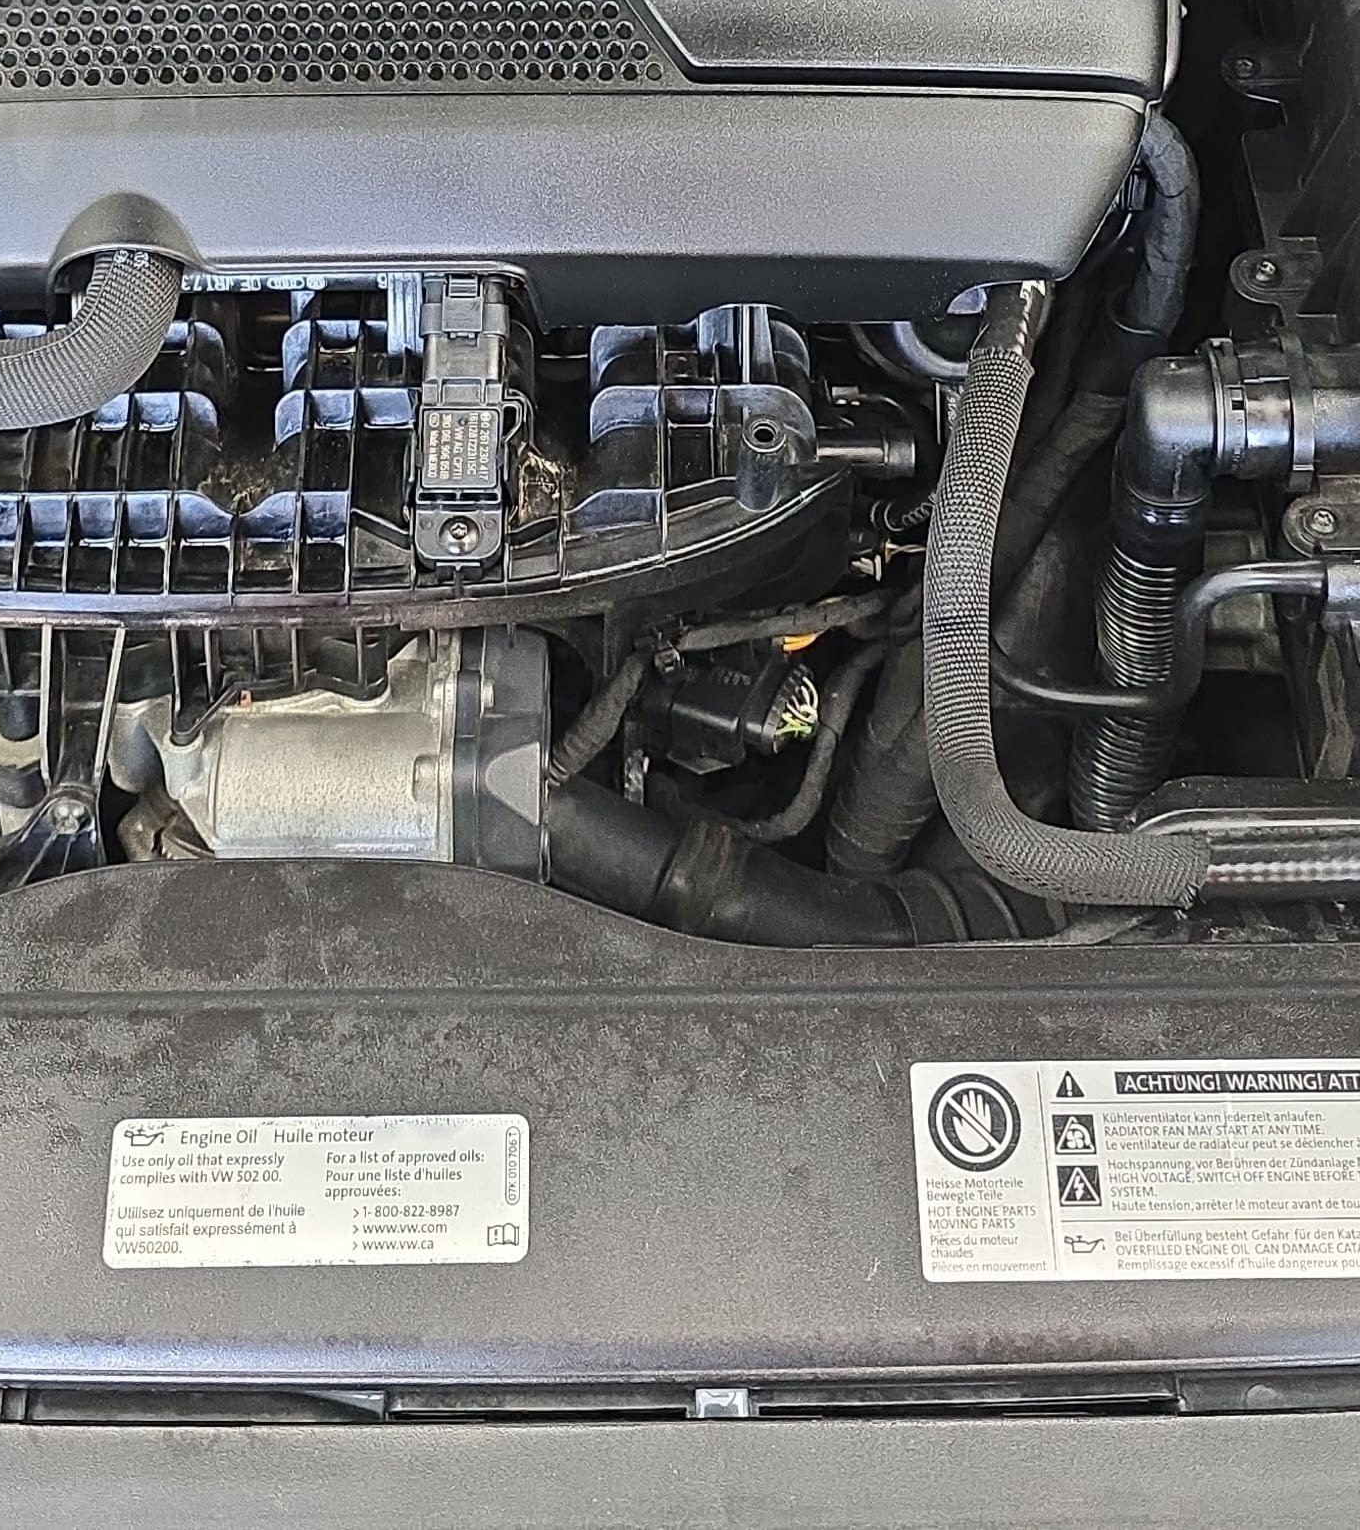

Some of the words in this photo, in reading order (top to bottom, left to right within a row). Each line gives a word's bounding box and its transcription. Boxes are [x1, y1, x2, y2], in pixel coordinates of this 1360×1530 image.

[454, 427, 464, 441] VW
[480, 430, 490, 445] 261
[453, 441, 464, 454] AG
[480, 446, 489, 463] 230
[479, 465, 489, 480] 417
[1124, 1073, 1221, 1092] ACHTUNG!
[1225, 1073, 1325, 1091] WARNING!
[1102, 1112, 1191, 1124] Kühlerventilator
[1193, 1111, 1221, 1122] kann
[1223, 1111, 1274, 1126] jederzeit
[1274, 1110, 1325, 1122] anlaufen.
[1104, 1125, 1160, 1137] RADIATOR
[1162, 1125, 1185, 1136] FAN
[1188, 1125, 1213, 1136] MAY
[1215, 1125, 1248, 1136] START
[1251, 1124, 1265, 1135] AT
[1267, 1124, 1291, 1135] ANY
[1293, 1124, 1325, 1135] TIME.
[180, 1130, 232, 1149] Engine
[236, 1129, 257, 1144] Oil
[274, 1129, 314, 1144] Huile
[318, 1128, 375, 1143] moteur
[1105, 1140, 1119, 1151] Le
[1121, 1139, 1181, 1150] ventilateur
[1183, 1138, 1197, 1150] de
[1199, 1138, 1250, 1150] radiateur
[1253, 1139, 1278, 1152] peut
[1280, 1139, 1292, 1149] se
[1296, 1137, 1354, 1149] déclencher
[508, 1138, 518, 1159] 706
[122, 1155, 145, 1167] Use
[148, 1153, 174, 1170] only
[177, 1153, 193, 1166] oil
[197, 1153, 223, 1166] that
[226, 1152, 285, 1169] expressly
[326, 1151, 347, 1164] For
[349, 1154, 356, 1163] a
[360, 1151, 379, 1163] list
[382, 1150, 396, 1163] of
[398, 1150, 456, 1166] approved
[459, 1149, 485, 1163] oils:
[1108, 1158, 1195, 1172] Hochspannung,
[1196, 1160, 1216, 1169] vor
[1216, 1158, 1267, 1169] Berühren
[1269, 1157, 1286, 1168] der
[1289, 1157, 1355, 1170] Zündanlage
[326, 1170, 355, 1182] Pour
[358, 1171, 381, 1181] une
[384, 1169, 411, 1181] liste
[414, 1168, 462, 1181] d'huiles
[508, 1160, 518, 1179] 010
[1109, 1172, 1139, 1183] HIGH
[1141, 1172, 1195, 1184] VOLTAGE,
[1197, 1171, 1241, 1183] SWITCH
[1243, 1171, 1265, 1182] OFF
[1267, 1170, 1310, 1182] ENGINE
[1313, 1170, 1355, 1181] BEFORE
[120, 1171, 175, 1187] complies
[179, 1171, 208, 1183] with
[211, 1171, 234, 1183] VW
[237, 1170, 259, 1183] 502
[262, 1170, 282, 1183] 00.
[926, 1178, 962, 1189] Heisse
[965, 1177, 1024, 1189] Motorteile
[325, 1185, 401, 1201] approuvées:
[927, 1190, 975, 1204] Bewegte
[978, 1190, 1004, 1201] Teile
[1110, 1186, 1158, 1197] SYSTEM.
[118, 1206, 165, 1219] Utilisez
[168, 1205, 245, 1221] uniquement
[248, 1205, 265, 1218] de
[268, 1204, 306, 1217] l'huile
[928, 1206, 951, 1217] HOT
[956, 1205, 1000, 1217] ENGINE
[1002, 1205, 1037, 1216] PARTS
[116, 1223, 136, 1239] qui
[139, 1223, 189, 1237] satisfait
[193, 1221, 285, 1238] expressément
[288, 1221, 297, 1234] à
[362, 1224, 448, 1234] www.vw.com
[928, 1218, 978, 1230] MOVING
[982, 1218, 1016, 1229] PARTS
[964, 1234, 977, 1245] du
[980, 1235, 1019, 1245] moteur
[1115, 1230, 1132, 1242] Bei
[1134, 1229, 1203, 1244] Überfüllung
[1206, 1230, 1248, 1241] besteht
[1251, 1229, 1290, 1241] Gefahr
[1294, 1229, 1311, 1240] für
[1314, 1228, 1335, 1240] den
[115, 1241, 183, 1254] VW50200.
[362, 1240, 434, 1251] www.vw.ca
[930, 1247, 974, 1258] chaudes
[1116, 1245, 1182, 1256] OVERFILLED
[1185, 1244, 1228, 1256] ENGINE
[1231, 1244, 1250, 1255] OIL
[1255, 1244, 1279, 1255] CAN
[1282, 1243, 1334, 1254] DAMAGE
